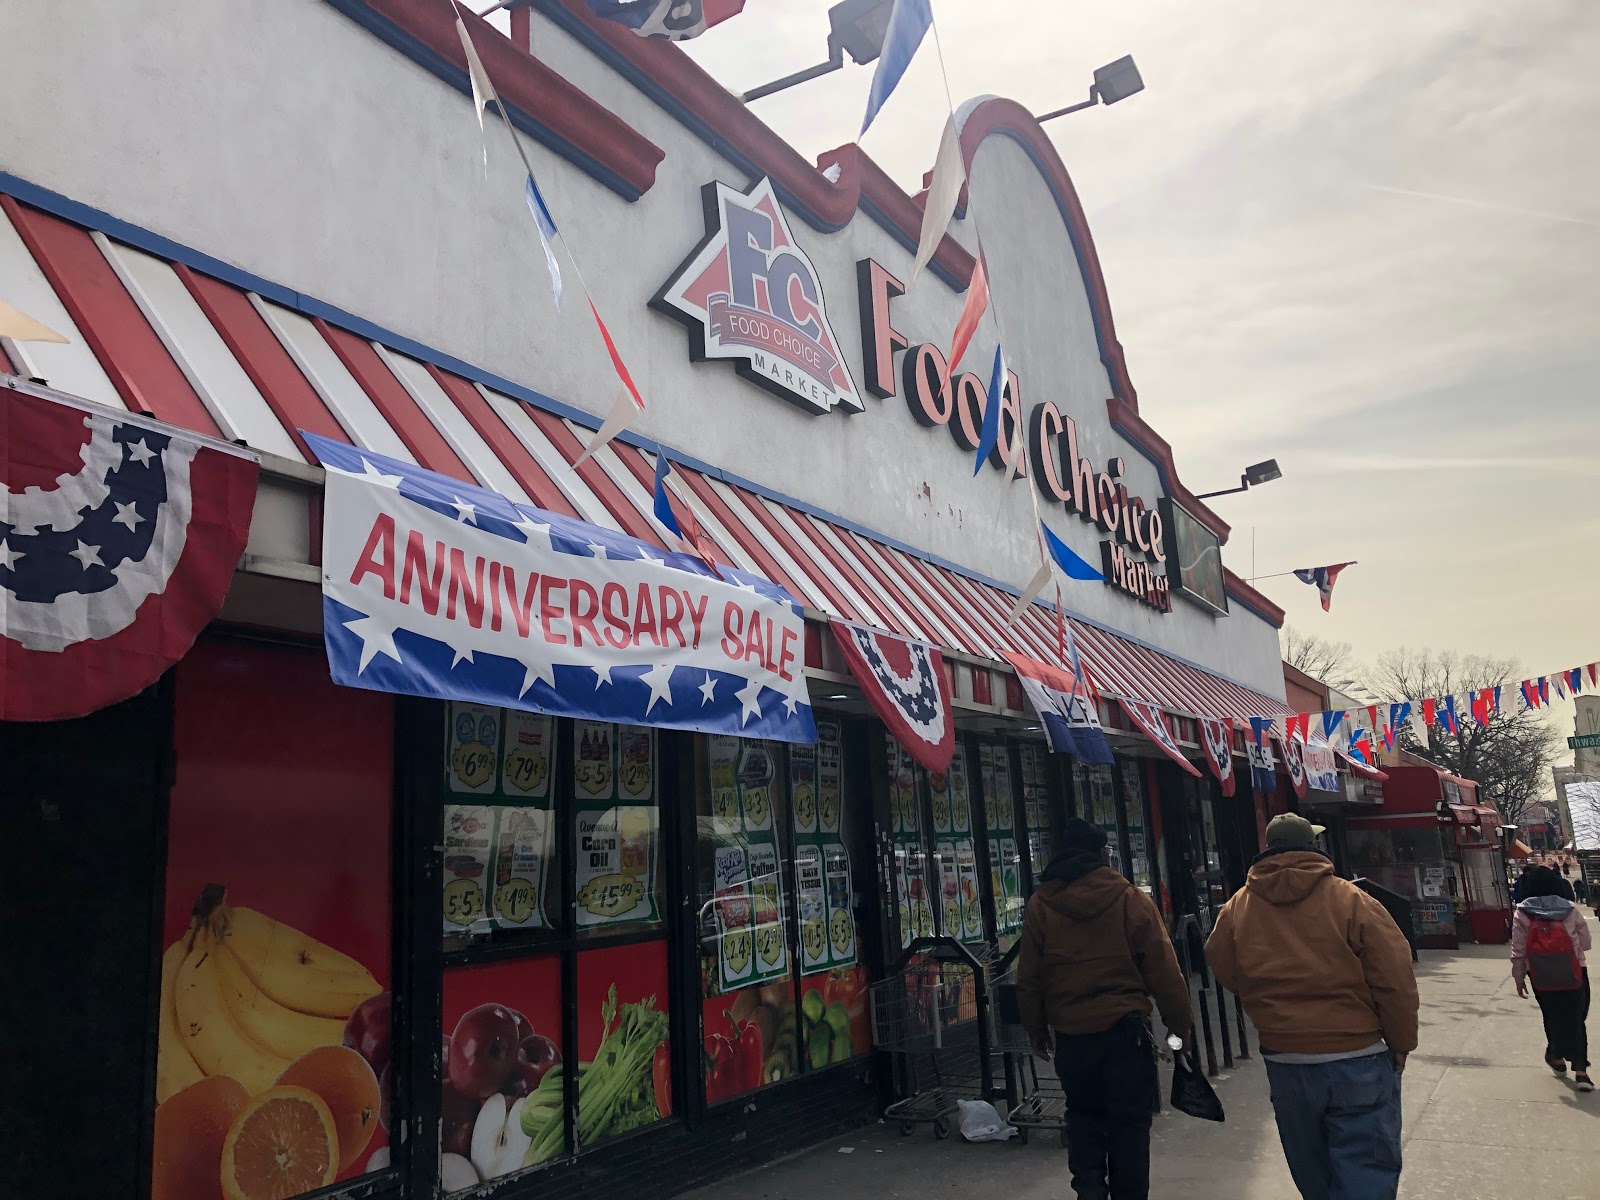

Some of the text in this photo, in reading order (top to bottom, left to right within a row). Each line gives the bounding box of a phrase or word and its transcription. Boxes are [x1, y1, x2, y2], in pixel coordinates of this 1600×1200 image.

[725, 198, 822, 342] FC
[730, 315, 821, 370] FOOD CHOICE
[755, 353, 831, 405] MARKET
[857, 258, 1168, 562] Food Choice
[350, 512, 798, 690] ANNIVERSARY SALE
[1100, 541, 1172, 613] Market
[446, 835, 489, 848] Sardines
[580, 820, 610, 832] Avenue
[582, 836, 616, 851] Corn
[590, 852, 608, 867] Oil
[751, 862, 775, 878] Coffee
